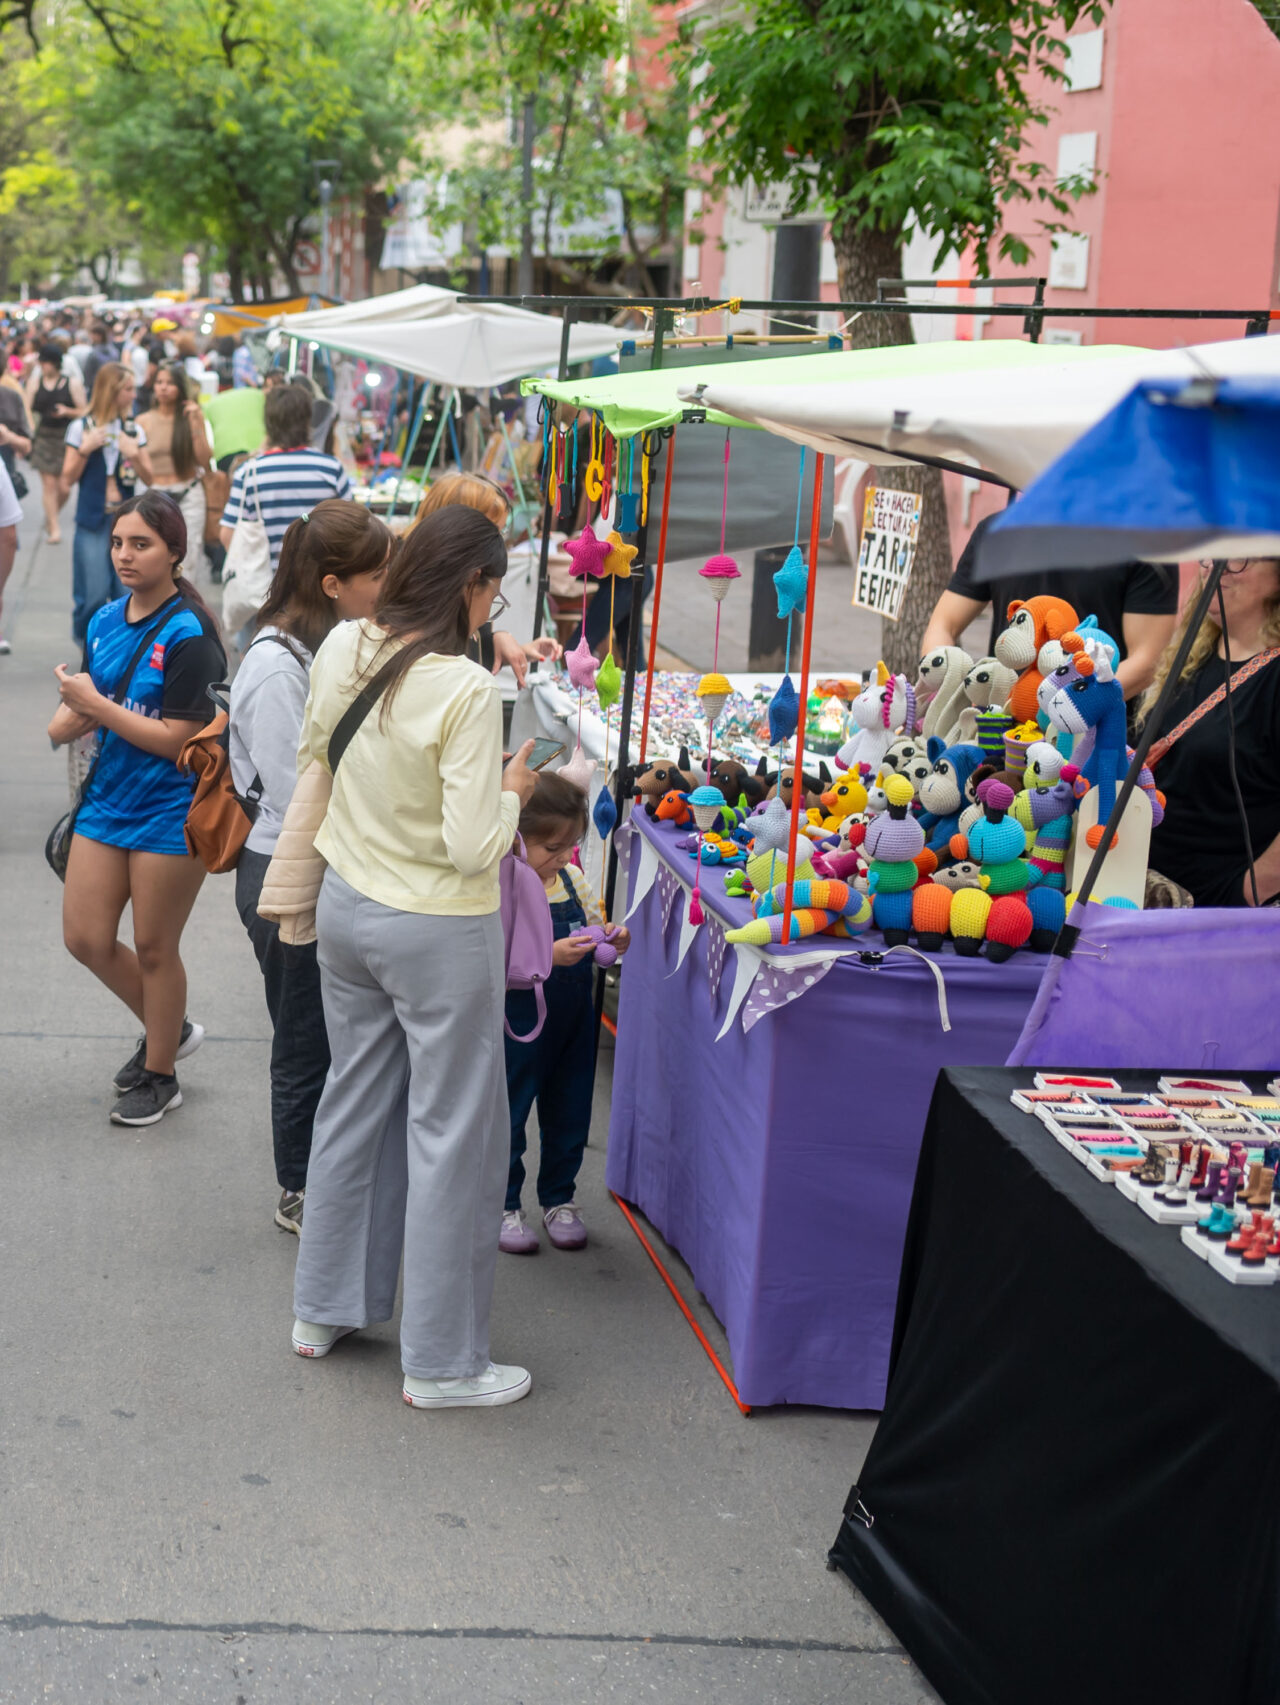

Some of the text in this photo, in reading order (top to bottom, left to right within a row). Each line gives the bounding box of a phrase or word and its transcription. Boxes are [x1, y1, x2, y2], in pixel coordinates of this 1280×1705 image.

[874, 491, 914, 514] SE HACEN
[872, 511, 913, 537] LECTURAS
[864, 531, 916, 577] TAROT
